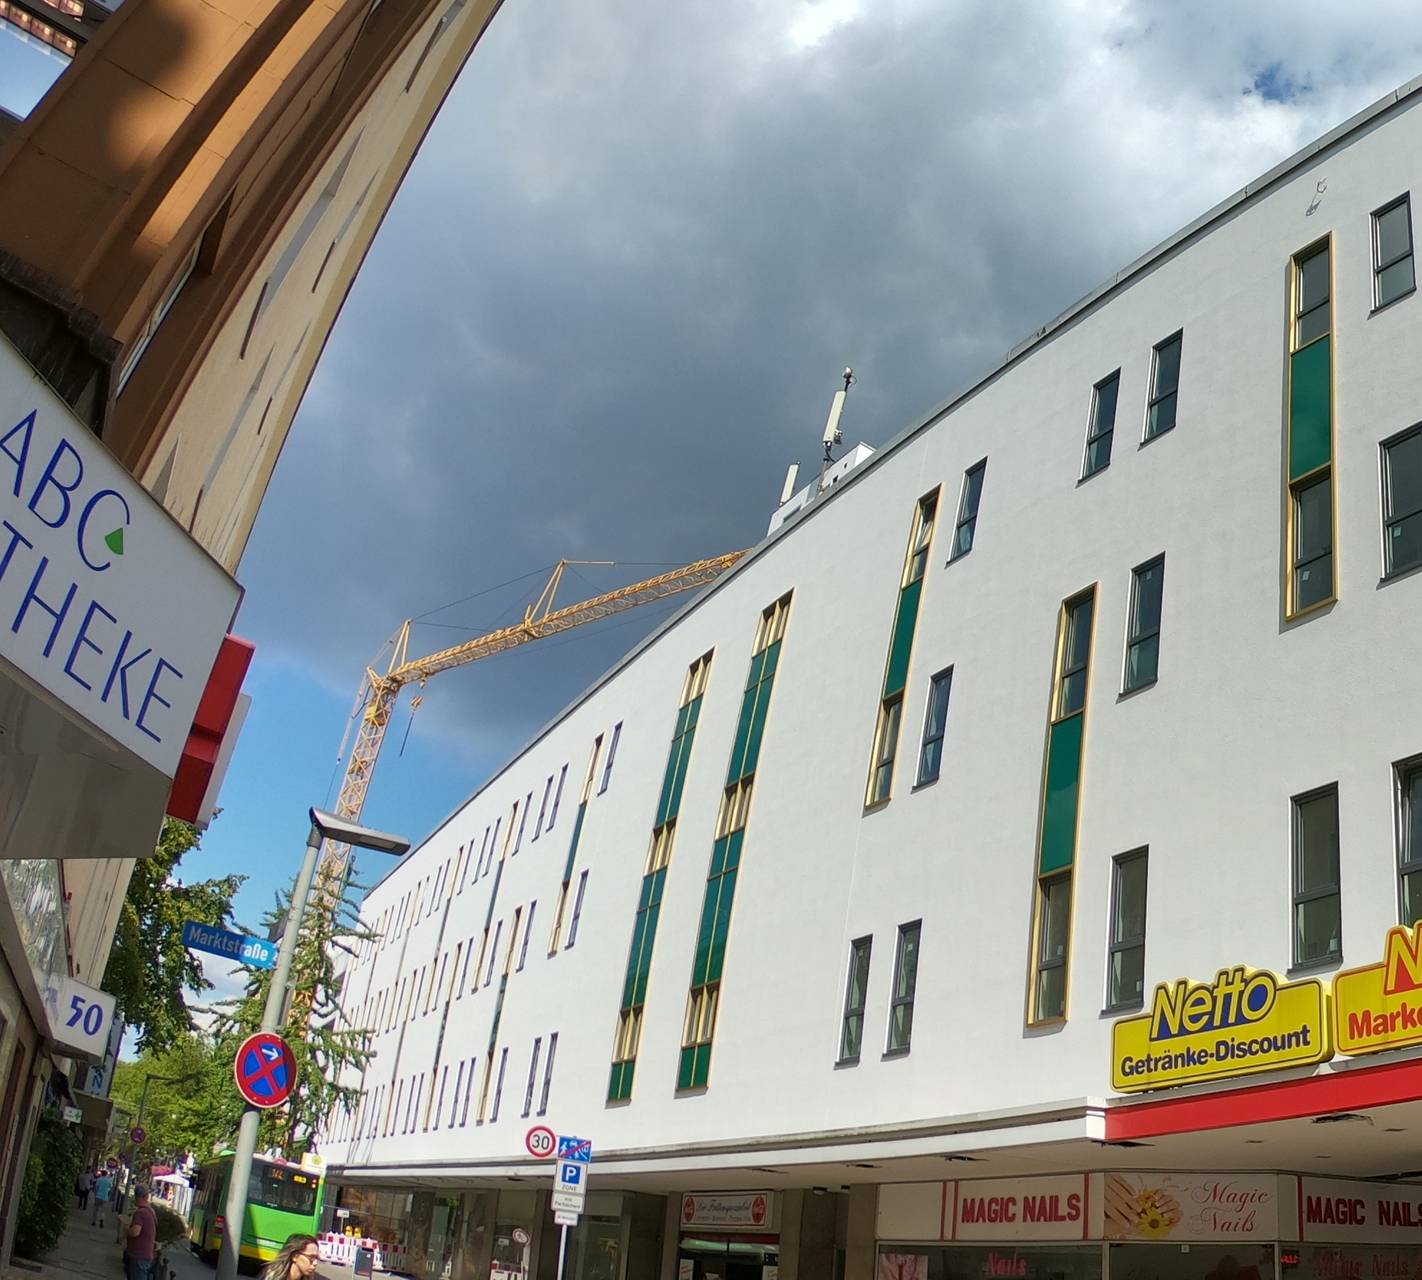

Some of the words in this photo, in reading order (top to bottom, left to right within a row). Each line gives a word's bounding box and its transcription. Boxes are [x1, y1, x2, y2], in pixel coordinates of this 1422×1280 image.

[0, 409, 130, 571] ABC
[188, 925, 269, 962] Marktstraße
[66, 994, 103, 1036] 50
[1150, 967, 1277, 1042] Netto
[1119, 1024, 1312, 1079] Getränke-Discount
[531, 1134, 550, 1151] 30
[565, 1166, 577, 1181] P
[961, 1196, 1017, 1224] MAGIC
[1022, 1193, 1081, 1223] NAILS
[1190, 1180, 1269, 1213] Magic
[1306, 1195, 1366, 1225] MAGIC
